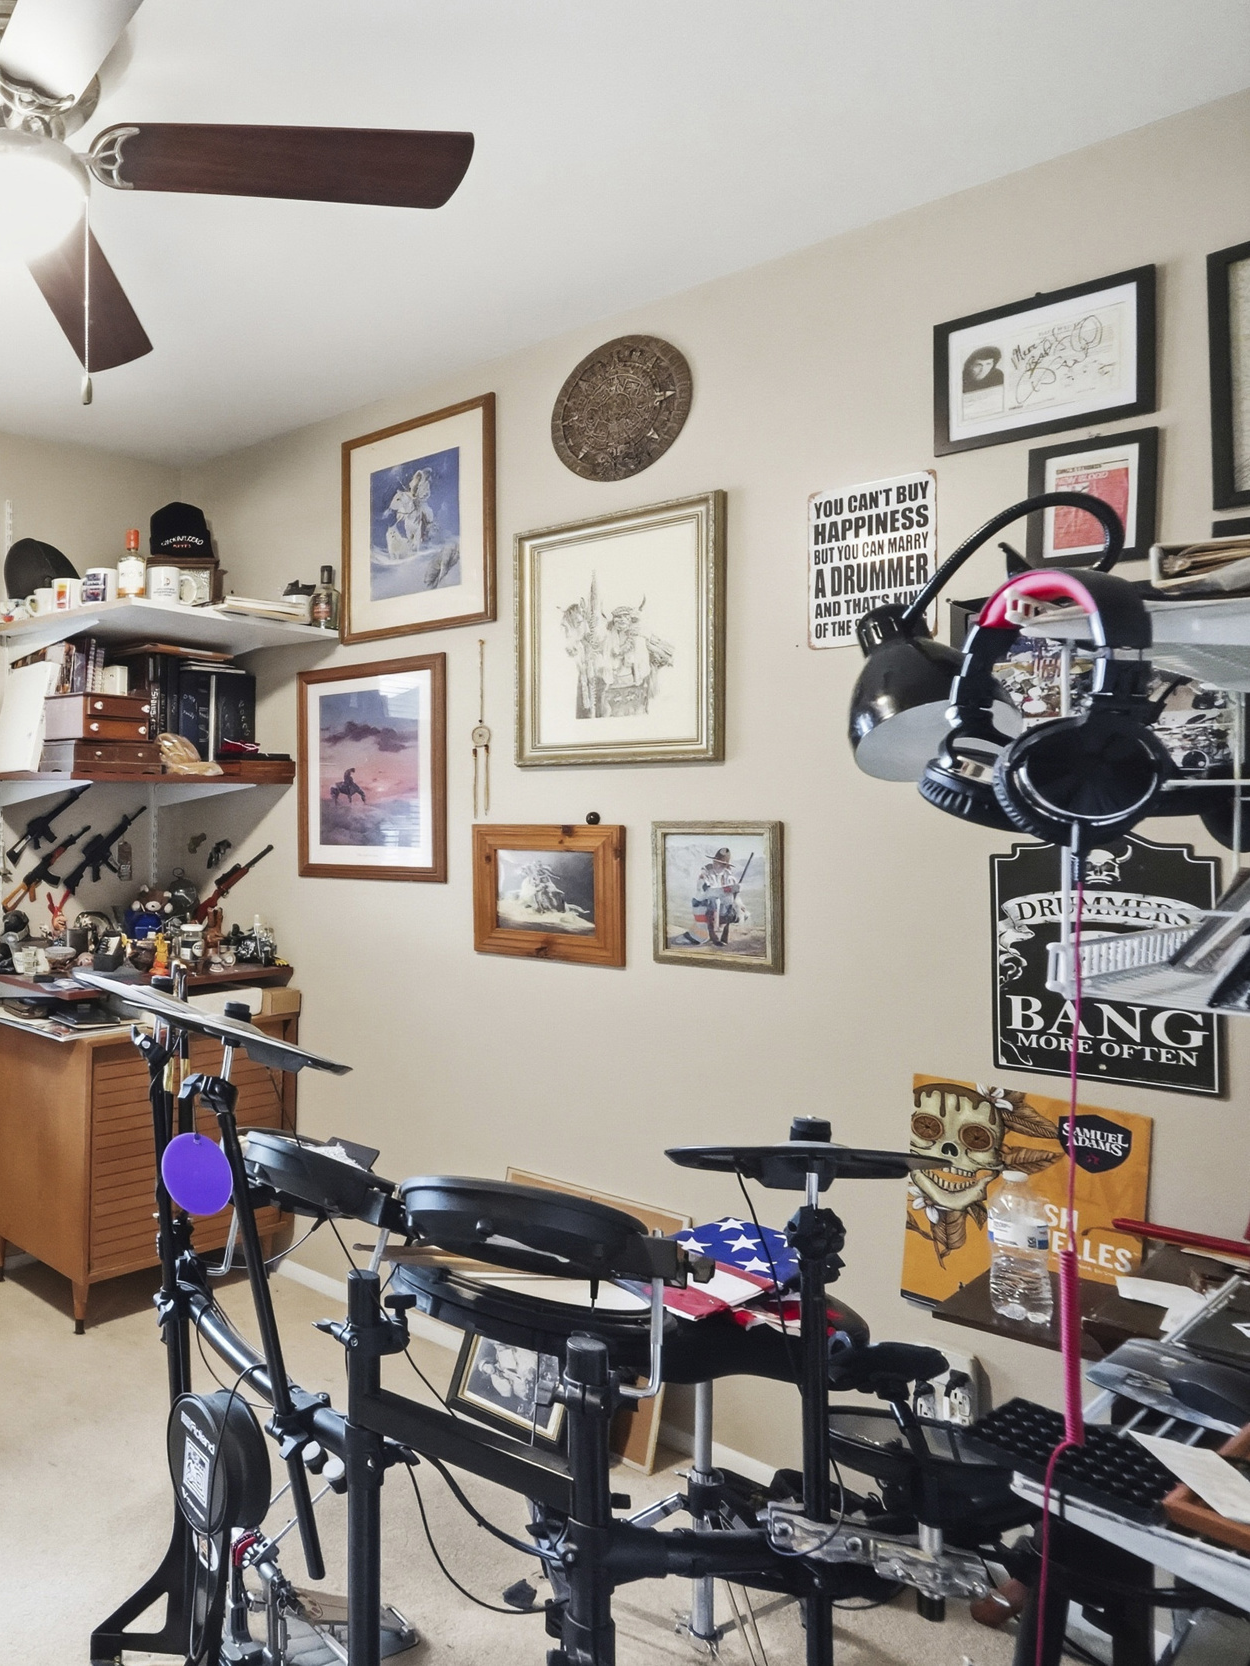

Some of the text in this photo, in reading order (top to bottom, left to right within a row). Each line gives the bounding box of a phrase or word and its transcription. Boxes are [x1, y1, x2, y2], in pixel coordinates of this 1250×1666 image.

[814, 480, 929, 519] YOU CAN'T BUY
[813, 504, 929, 546] HAPPINESS
[814, 531, 929, 565] BUT YOU CAN MARRY
[814, 552, 928, 599] A DRUMMER
[815, 601, 842, 619] AND
[815, 619, 852, 639] OF THE
[1005, 994, 1210, 1048] BANG
[1016, 1032, 1199, 1067] MORE OFTEN
[1062, 1122, 1129, 1148] SAMUEL
[1066, 1135, 1123, 1157] ADAMS
